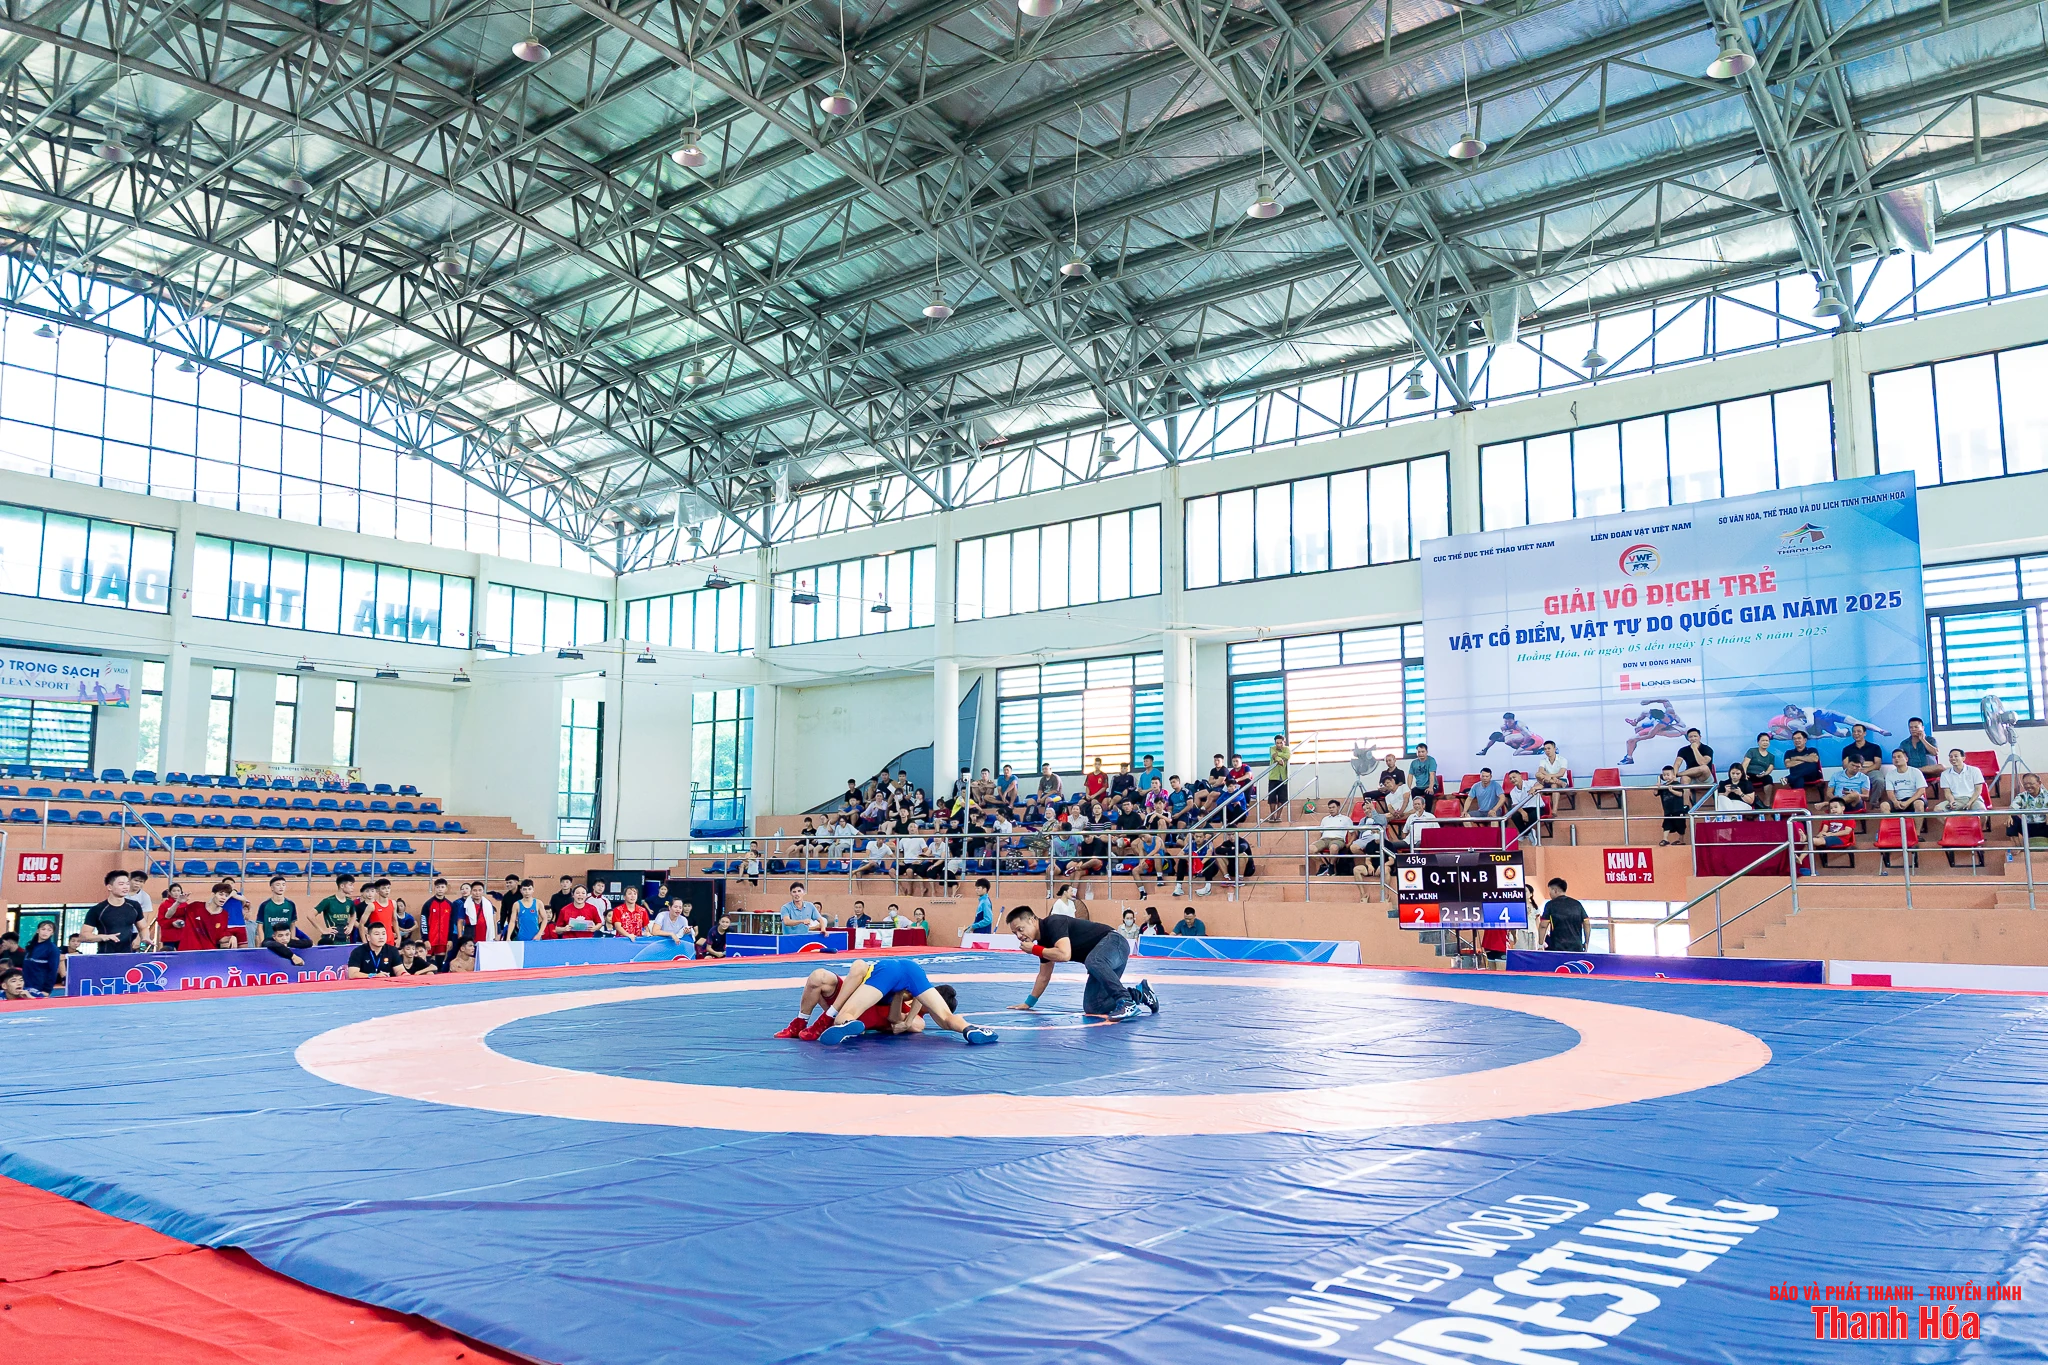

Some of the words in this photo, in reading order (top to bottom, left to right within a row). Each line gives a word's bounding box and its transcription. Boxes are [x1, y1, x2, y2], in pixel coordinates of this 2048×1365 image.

[1779, 506, 1798, 515] THAO
[1799, 504, 1810, 513] VÀ
[1823, 501, 1840, 510] LỊCH
[1861, 494, 1888, 505] THANH
[1634, 526, 1650, 536] VẬT
[1651, 524, 1670, 534] VIỆT
[1671, 522, 1692, 531] NAM
[1496, 546, 1516, 554] THAO
[1536, 540, 1555, 549] NAM
[1628, 553, 1652, 562] VWF
[1543, 587, 1596, 616] GIẢI
[1603, 583, 1638, 609] VÔ
[1646, 578, 1711, 607] ĐỊCH
[1719, 566, 1777, 598] TRẺ
[1449, 632, 1483, 652] VẬT
[1488, 624, 1510, 647] CỔ
[1515, 620, 1565, 645] ĐIỂN,
[1570, 619, 1608, 641] VẬT
[1614, 617, 1642, 637] TỰ
[1646, 615, 1673, 633] DO
[1679, 604, 1733, 632] QUỐC
[1739, 604, 1776, 624] GIA
[1782, 596, 1838, 619] NĂM
[1846, 590, 1902, 613] 2025
[1517, 650, 1551, 662] Hoằng
[1555, 649, 1580, 659] Hóa,
[1583, 647, 1596, 657] từ
[1598, 645, 1623, 656] ngày
[1628, 643, 1641, 652] 05
[1644, 640, 1665, 651] đến
[1668, 640, 1696, 651] ngày
[1700, 637, 1713, 646] 15
[1717, 633, 1751, 645] tháng
[1755, 632, 1763, 641] 8
[1766, 630, 1793, 640] năm
[1798, 626, 1828, 637] 2025
[9, 660, 58, 674] TRONG
[62, 665, 101, 679] SẠCH
[0, 676, 31, 687] LEAN
[35, 679, 71, 690] SPORT
[1641, 679, 1671, 687] LONG
[23, 856, 48, 871] KHU
[50, 857, 59, 871] C
[1406, 856, 1427, 865] 45kg
[1455, 855, 1460, 863] 7
[1490, 854, 1512, 862] Tour
[1607, 852, 1634, 869] KHU
[1637, 851, 1647, 868] A
[1606, 871, 1615, 882] TỪ
[1616, 870, 1627, 882] SỐ:
[1628, 872, 1637, 881] 01
[1643, 872, 1652, 881] 72
[1400, 892, 1438, 900] N.T.MINH
[1482, 889, 1523, 899] P.V.NHÂN
[1414, 908, 1425, 923] 2
[1441, 907, 1480, 922] 2:15
[1499, 906, 1511, 923] 4
[180, 966, 289, 990] HOẰNG
[1222, 1255, 1464, 1349] UNITED
[1403, 1194, 1591, 1258] WORLD
